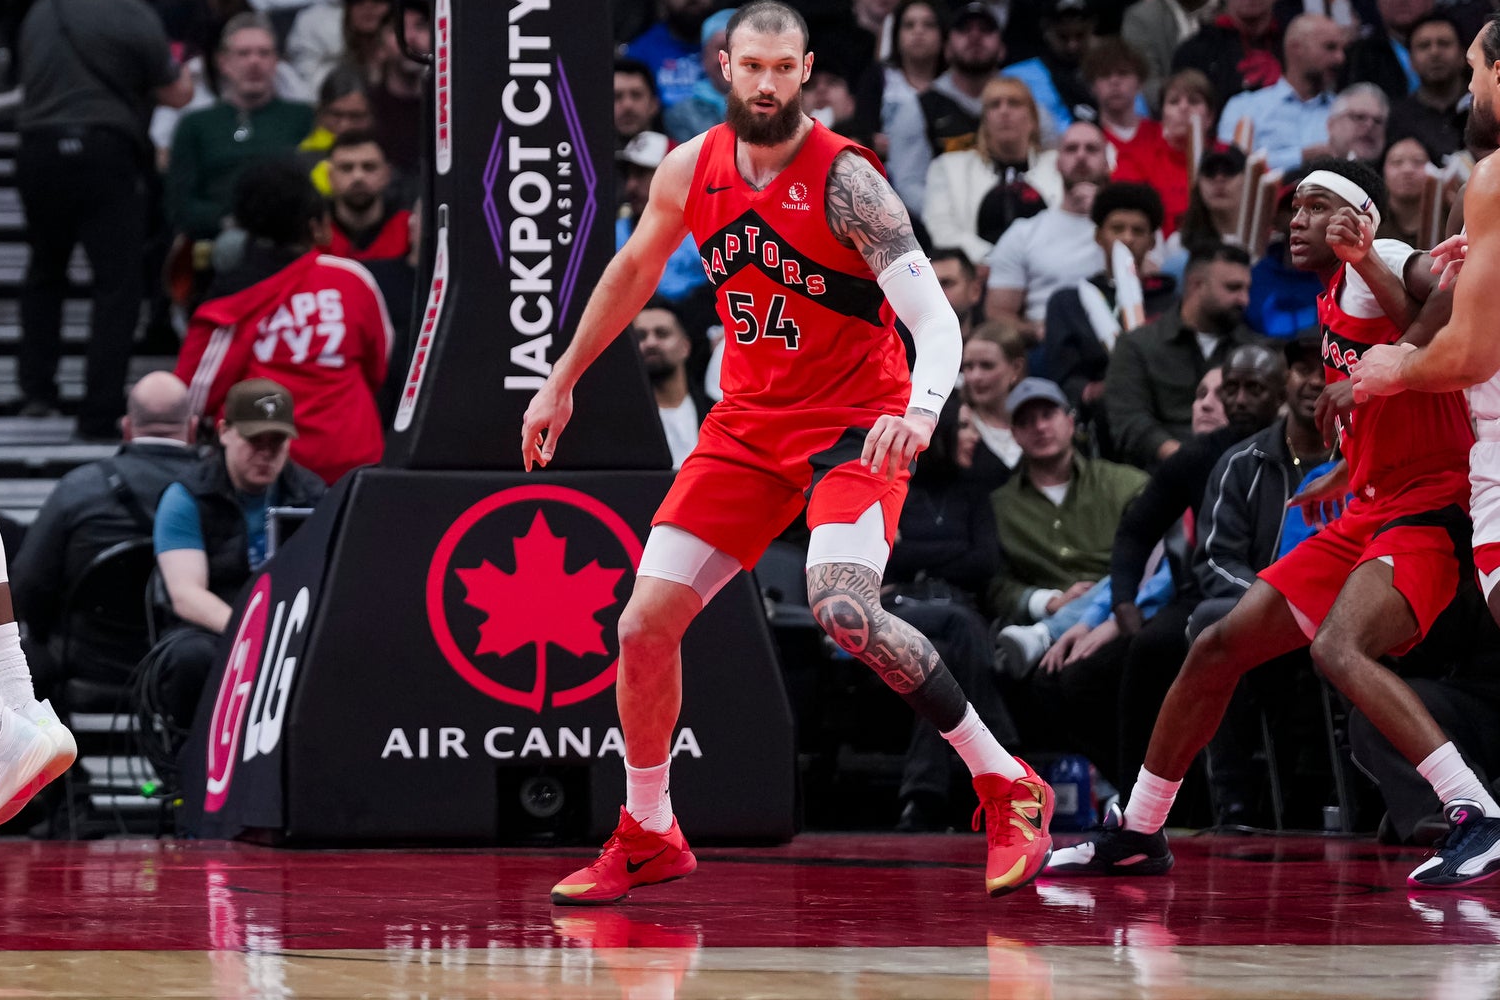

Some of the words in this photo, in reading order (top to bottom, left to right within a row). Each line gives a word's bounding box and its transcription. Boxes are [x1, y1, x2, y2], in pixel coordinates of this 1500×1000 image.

[556, 140, 573, 246] CASINO
[781, 201, 797, 210] Sun
[797, 202, 811, 211] Life
[503, 136, 554, 390] JACKPOT
[701, 225, 826, 296] RAPTORS
[725, 290, 801, 351] 54
[242, 585, 311, 762] LG
[380, 727, 470, 759] AIR
[483, 726, 703, 759] CANAA
